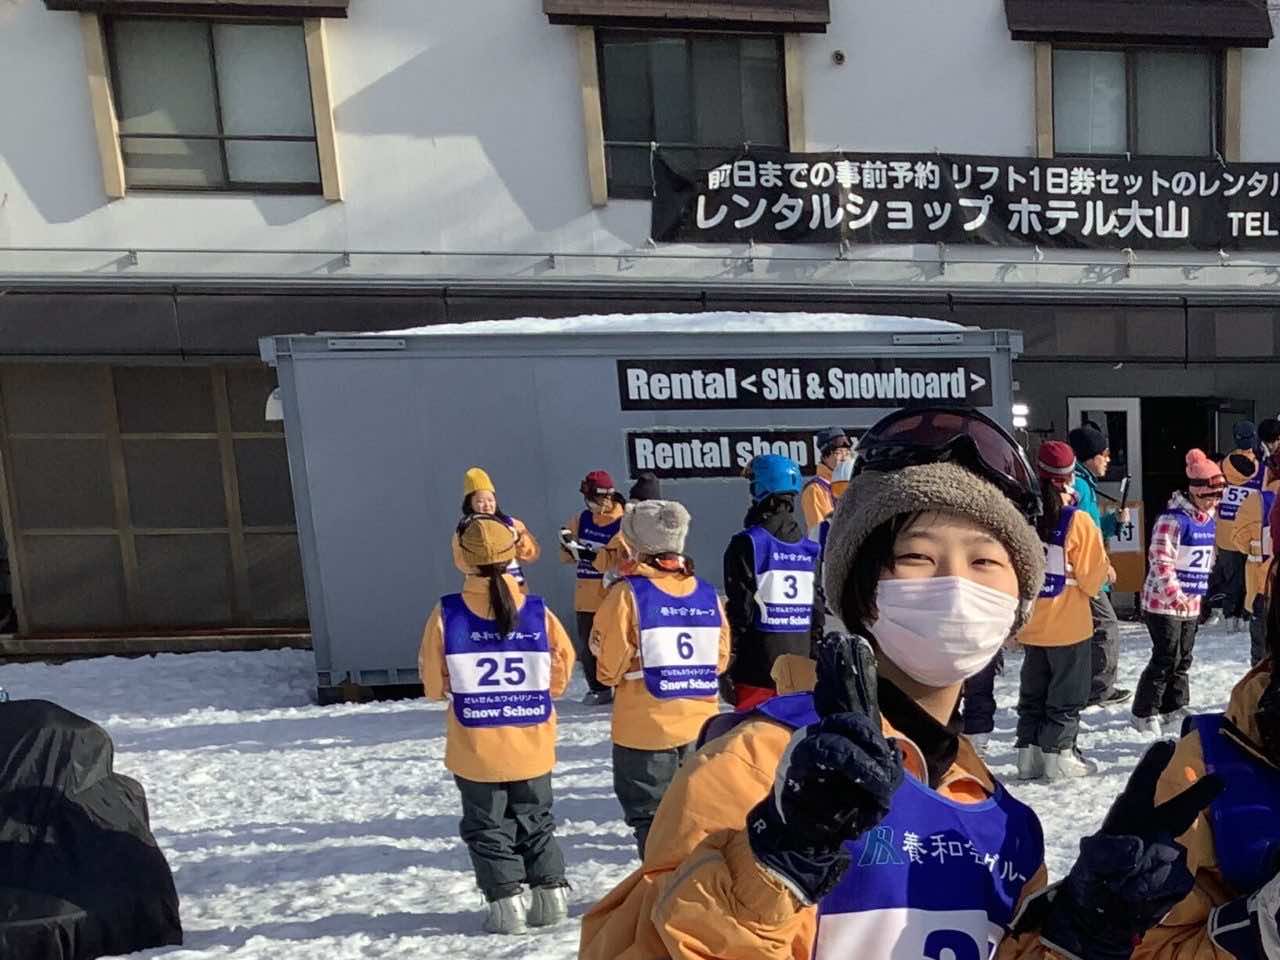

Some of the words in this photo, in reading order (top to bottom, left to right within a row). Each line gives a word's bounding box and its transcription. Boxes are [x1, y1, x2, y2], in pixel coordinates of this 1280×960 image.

[708, 160, 940, 190] 前日までの事前予約
[696, 193, 994, 231] レンタルショップ
[1008, 198, 1189, 238] ホテル大山
[626, 368, 737, 400] Rental
[806, 373, 825, 400] &
[635, 436, 731, 469] Rental
[783, 575, 798, 599] 3
[677, 632, 694, 660] 6
[476, 657, 526, 687] 25
[660, 680, 688, 691] Snow
[463, 707, 501, 719] Snow
[503, 705, 545, 717] School
